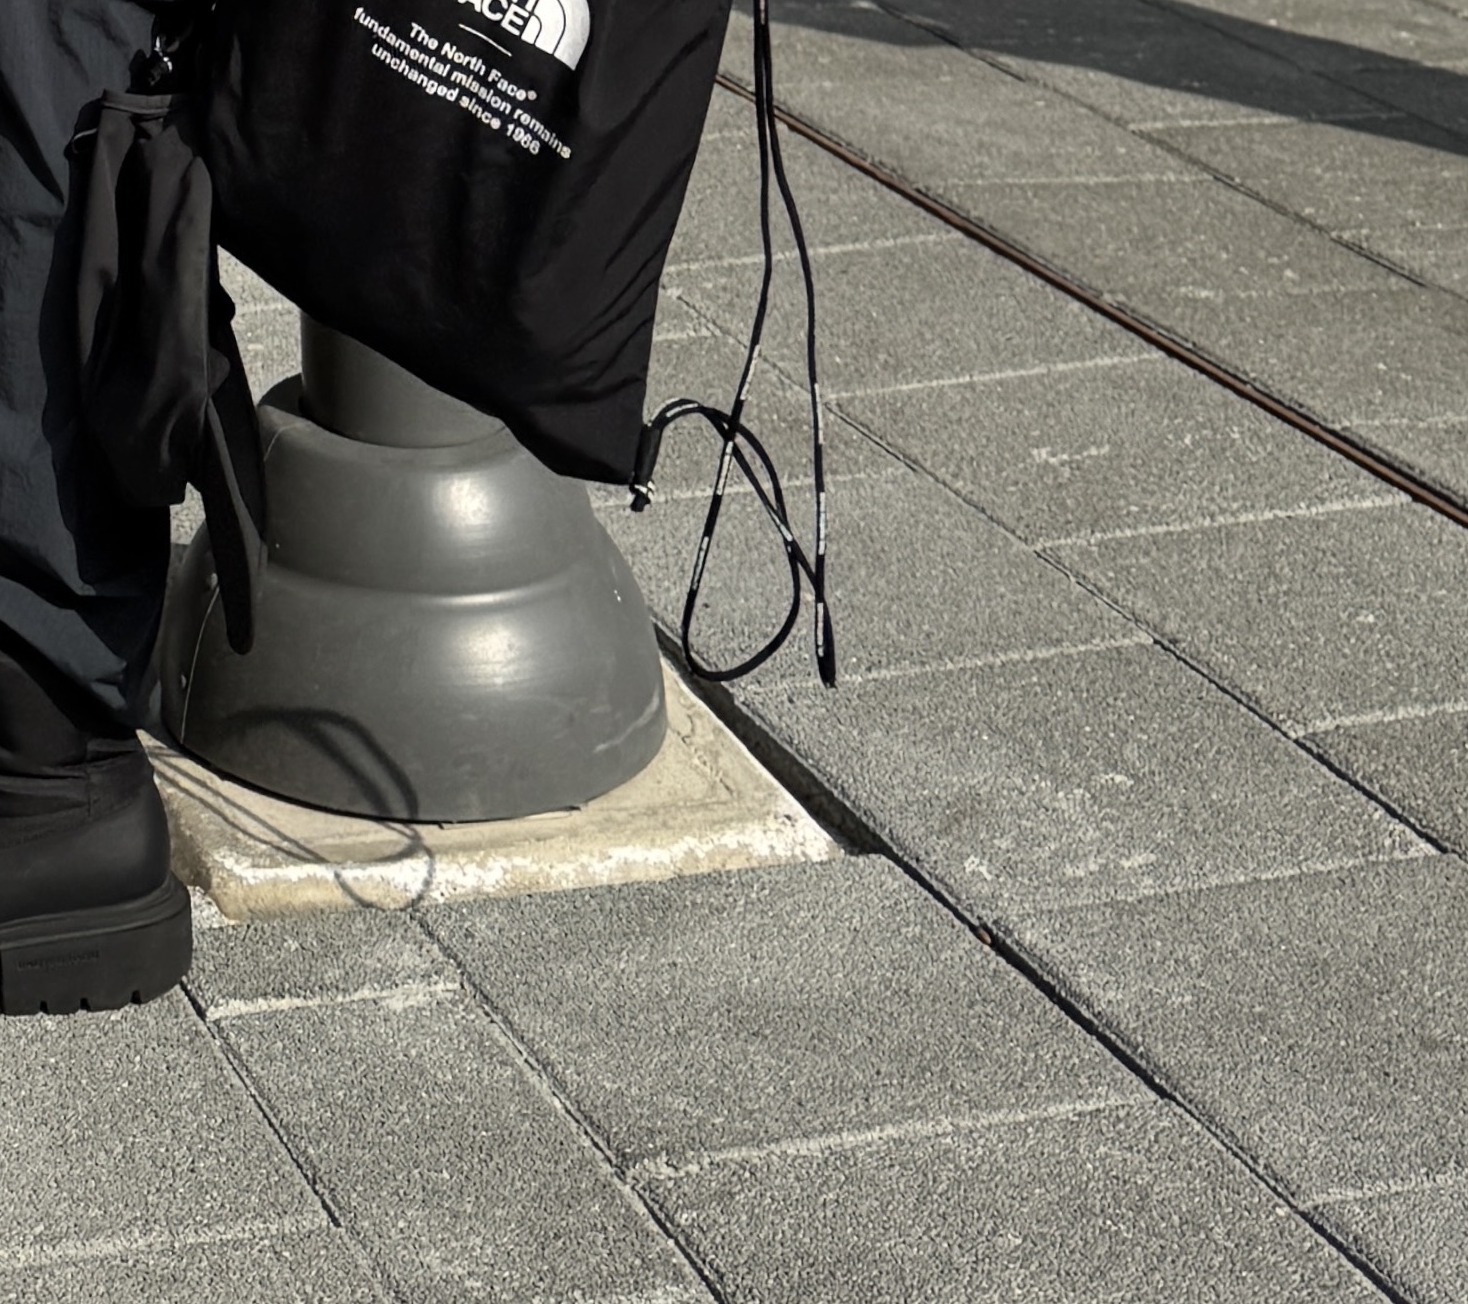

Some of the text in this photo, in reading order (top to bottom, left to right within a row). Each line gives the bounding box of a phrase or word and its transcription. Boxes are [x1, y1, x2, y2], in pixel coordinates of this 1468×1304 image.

[353, 6, 573, 160] fundamental mission remains
[371, 42, 542, 156] unchanged since 1966
[409, 22, 439, 51] The
[441, 42, 488, 77] North
